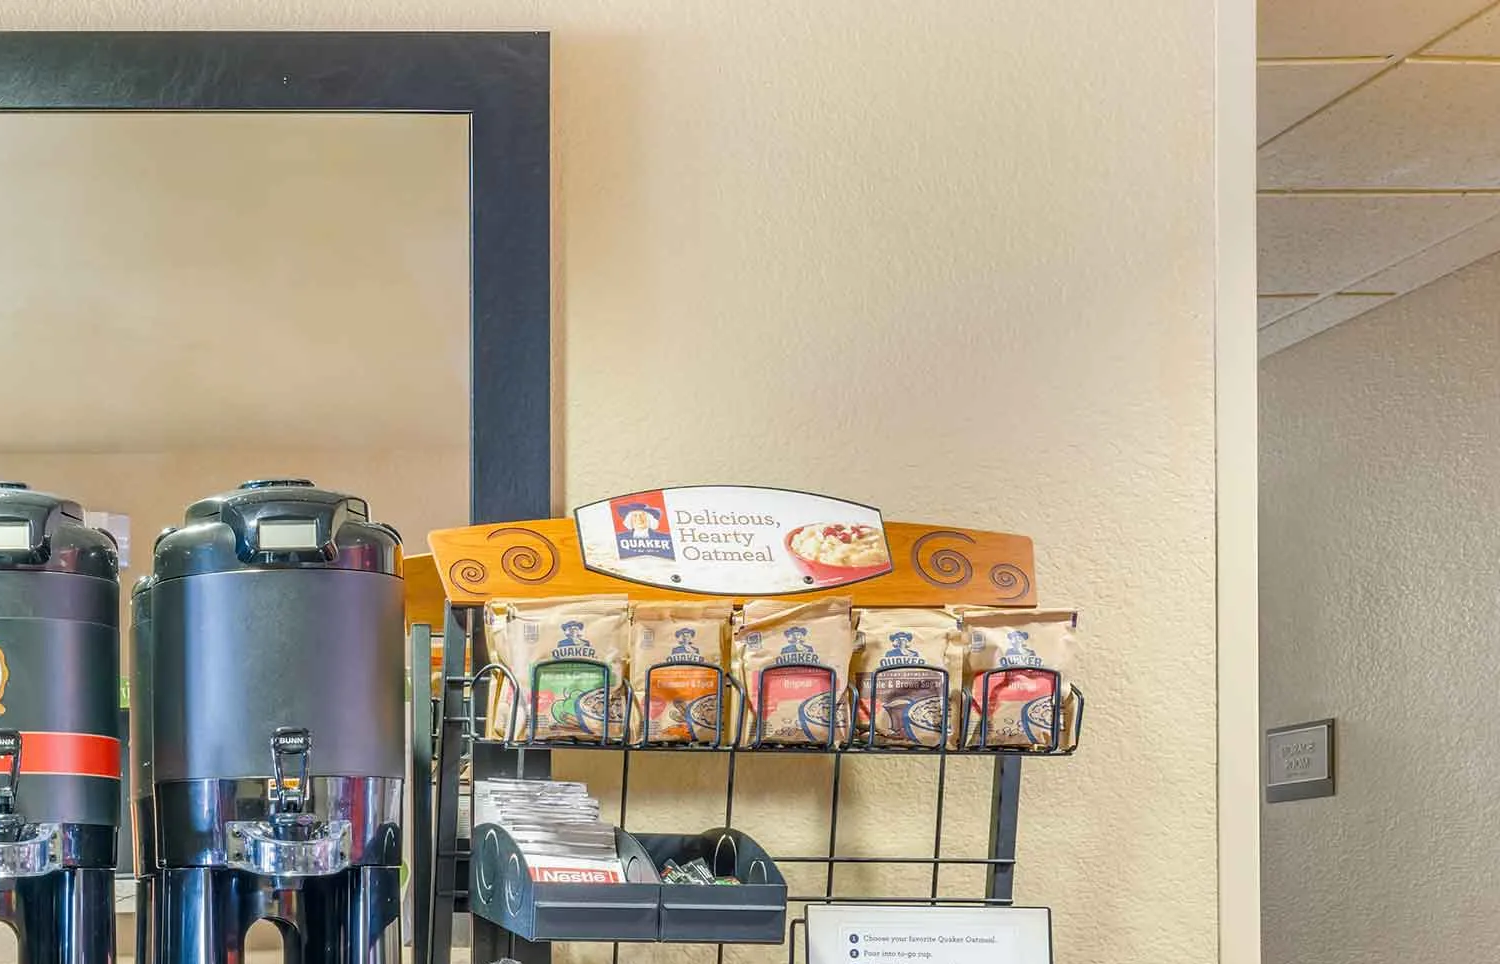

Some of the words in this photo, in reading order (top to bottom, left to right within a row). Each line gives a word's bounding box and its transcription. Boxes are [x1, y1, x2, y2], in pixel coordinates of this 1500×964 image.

[675, 508, 782, 528] Delicious,
[619, 538, 672, 551] QUAKER
[679, 528, 756, 547] Hearty
[683, 545, 775, 563] Oatmeal
[552, 647, 596, 660] QUAKER
[938, 935, 964, 943] Quaker
